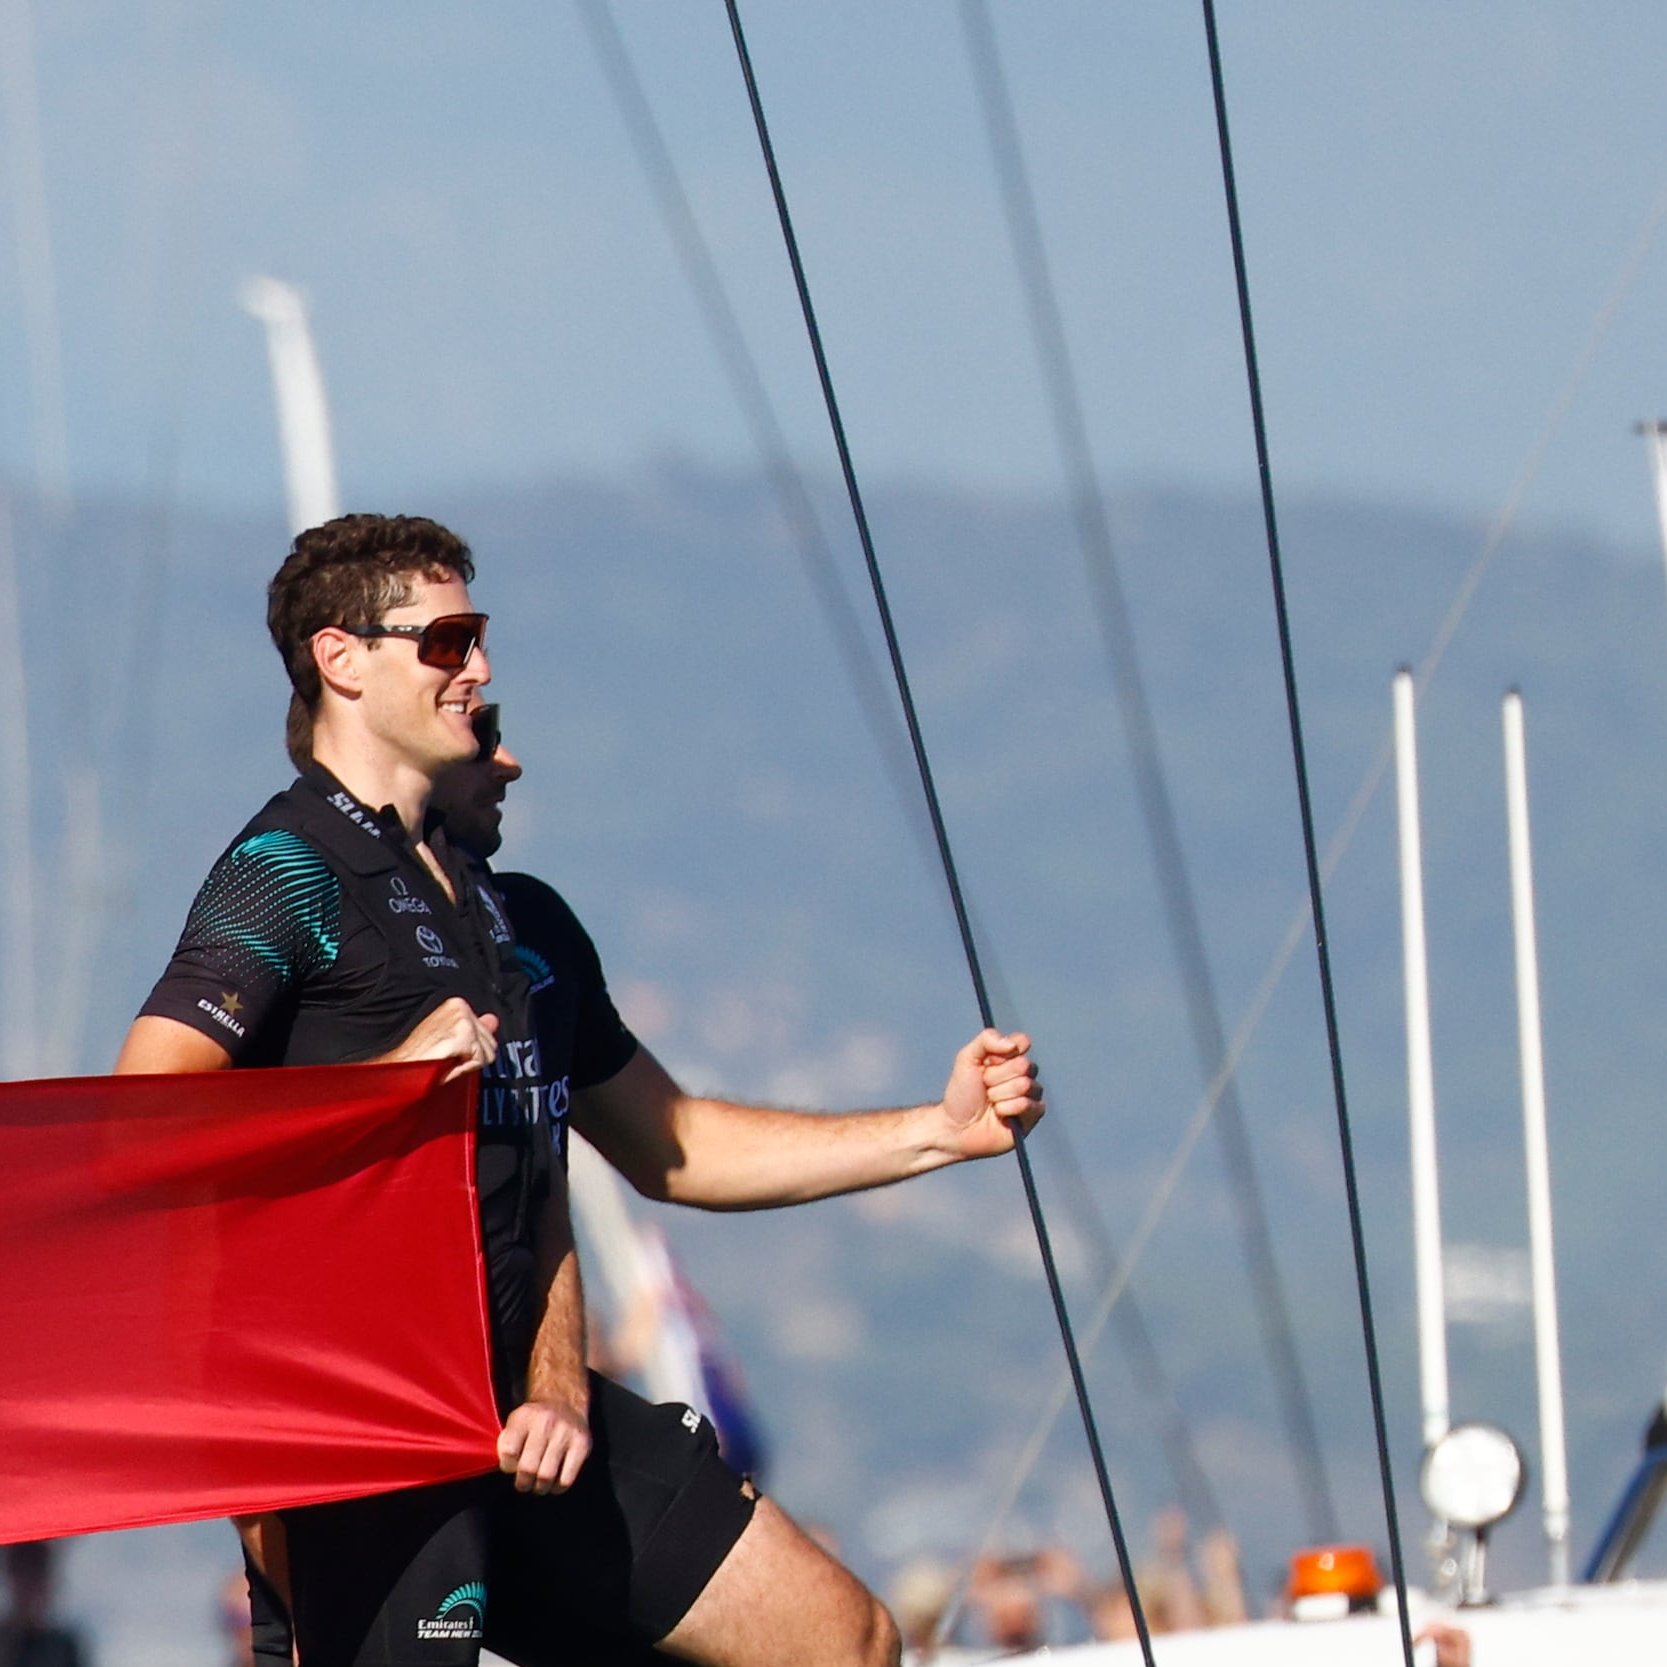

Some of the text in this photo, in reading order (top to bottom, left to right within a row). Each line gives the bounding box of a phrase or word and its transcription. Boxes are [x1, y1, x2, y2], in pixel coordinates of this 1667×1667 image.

[197, 998, 246, 1038] ESTRELLA
[417, 1619, 468, 1630] Emirates
[417, 1630, 450, 1639] TEAM
[450, 1630, 471, 1638] NEW
